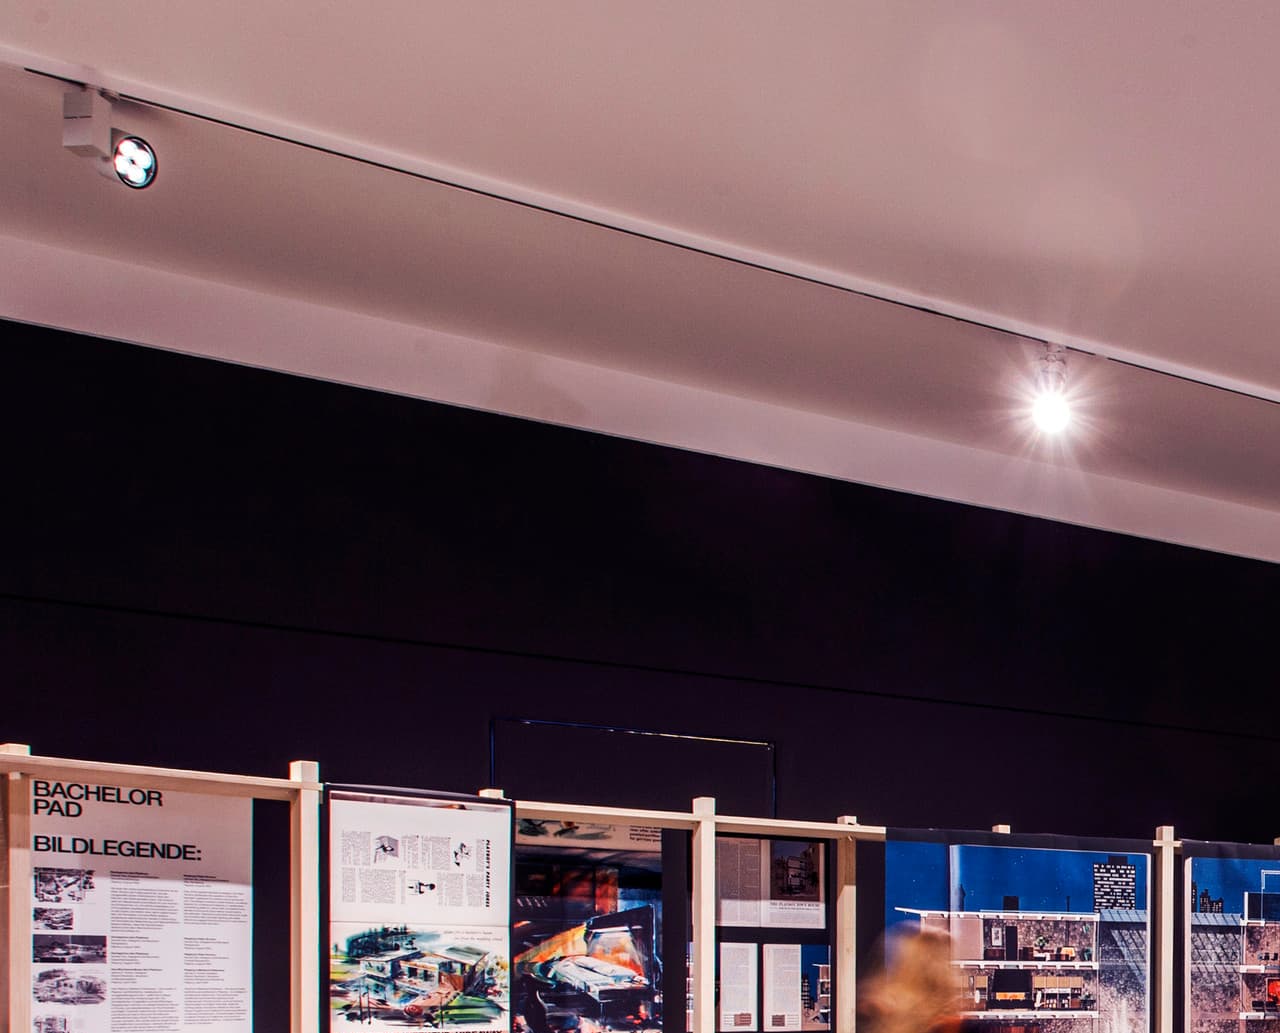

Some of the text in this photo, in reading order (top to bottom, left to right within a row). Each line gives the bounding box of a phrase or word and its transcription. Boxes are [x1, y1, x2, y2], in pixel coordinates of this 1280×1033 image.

[33, 780, 163, 806] BACHELOR
[33, 799, 83, 817] PAD
[33, 835, 202, 861] BILDLEGENDE:
